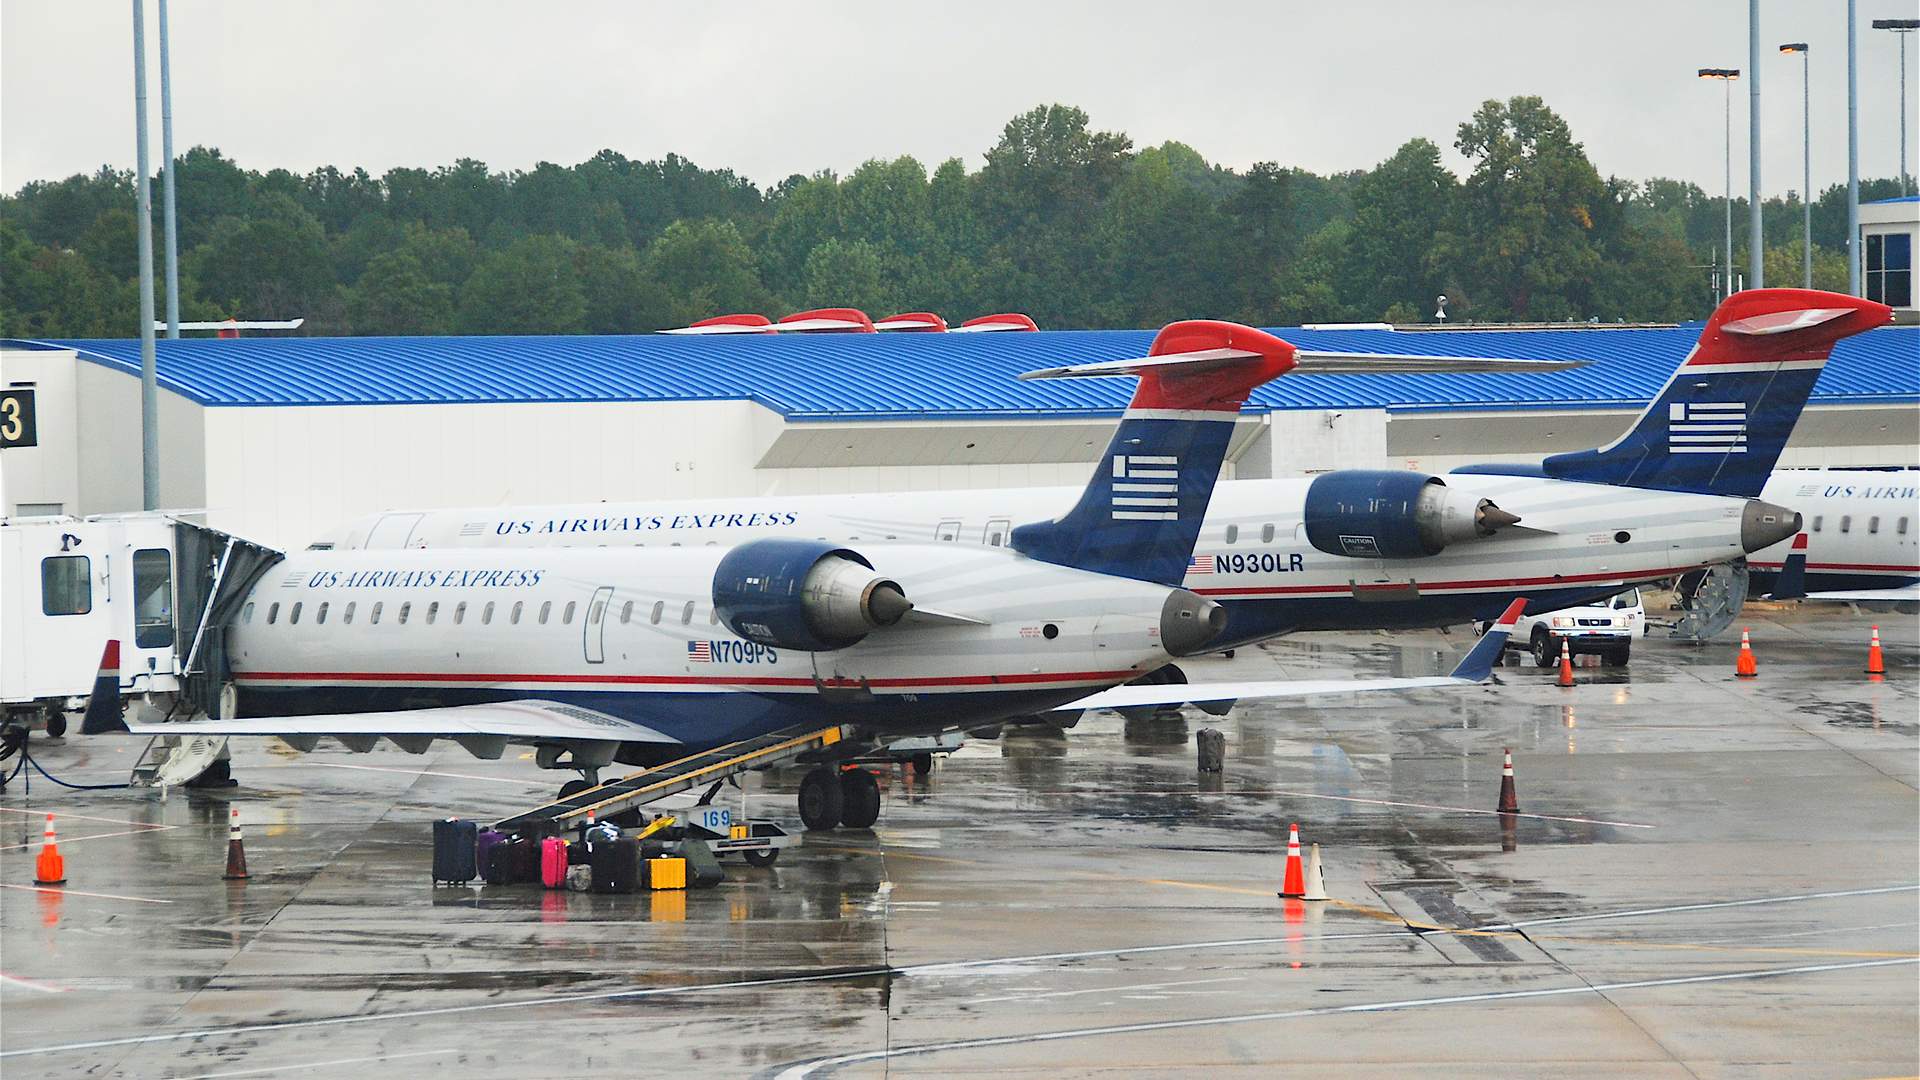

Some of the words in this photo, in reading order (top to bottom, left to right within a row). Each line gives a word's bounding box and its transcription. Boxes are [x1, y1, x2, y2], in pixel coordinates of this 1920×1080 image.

[1, 397, 22, 441] 3
[1858, 487, 1919, 499] AIRW
[539, 516, 662, 533] AIRWAYS
[670, 511, 798, 529] EXPRESS
[1216, 553, 1304, 574] N930LR
[342, 571, 442, 588] AIRWAYS
[440, 570, 546, 588] EXPRESS
[710, 640, 778, 664] N709PS
[703, 810, 730, 827] 169
